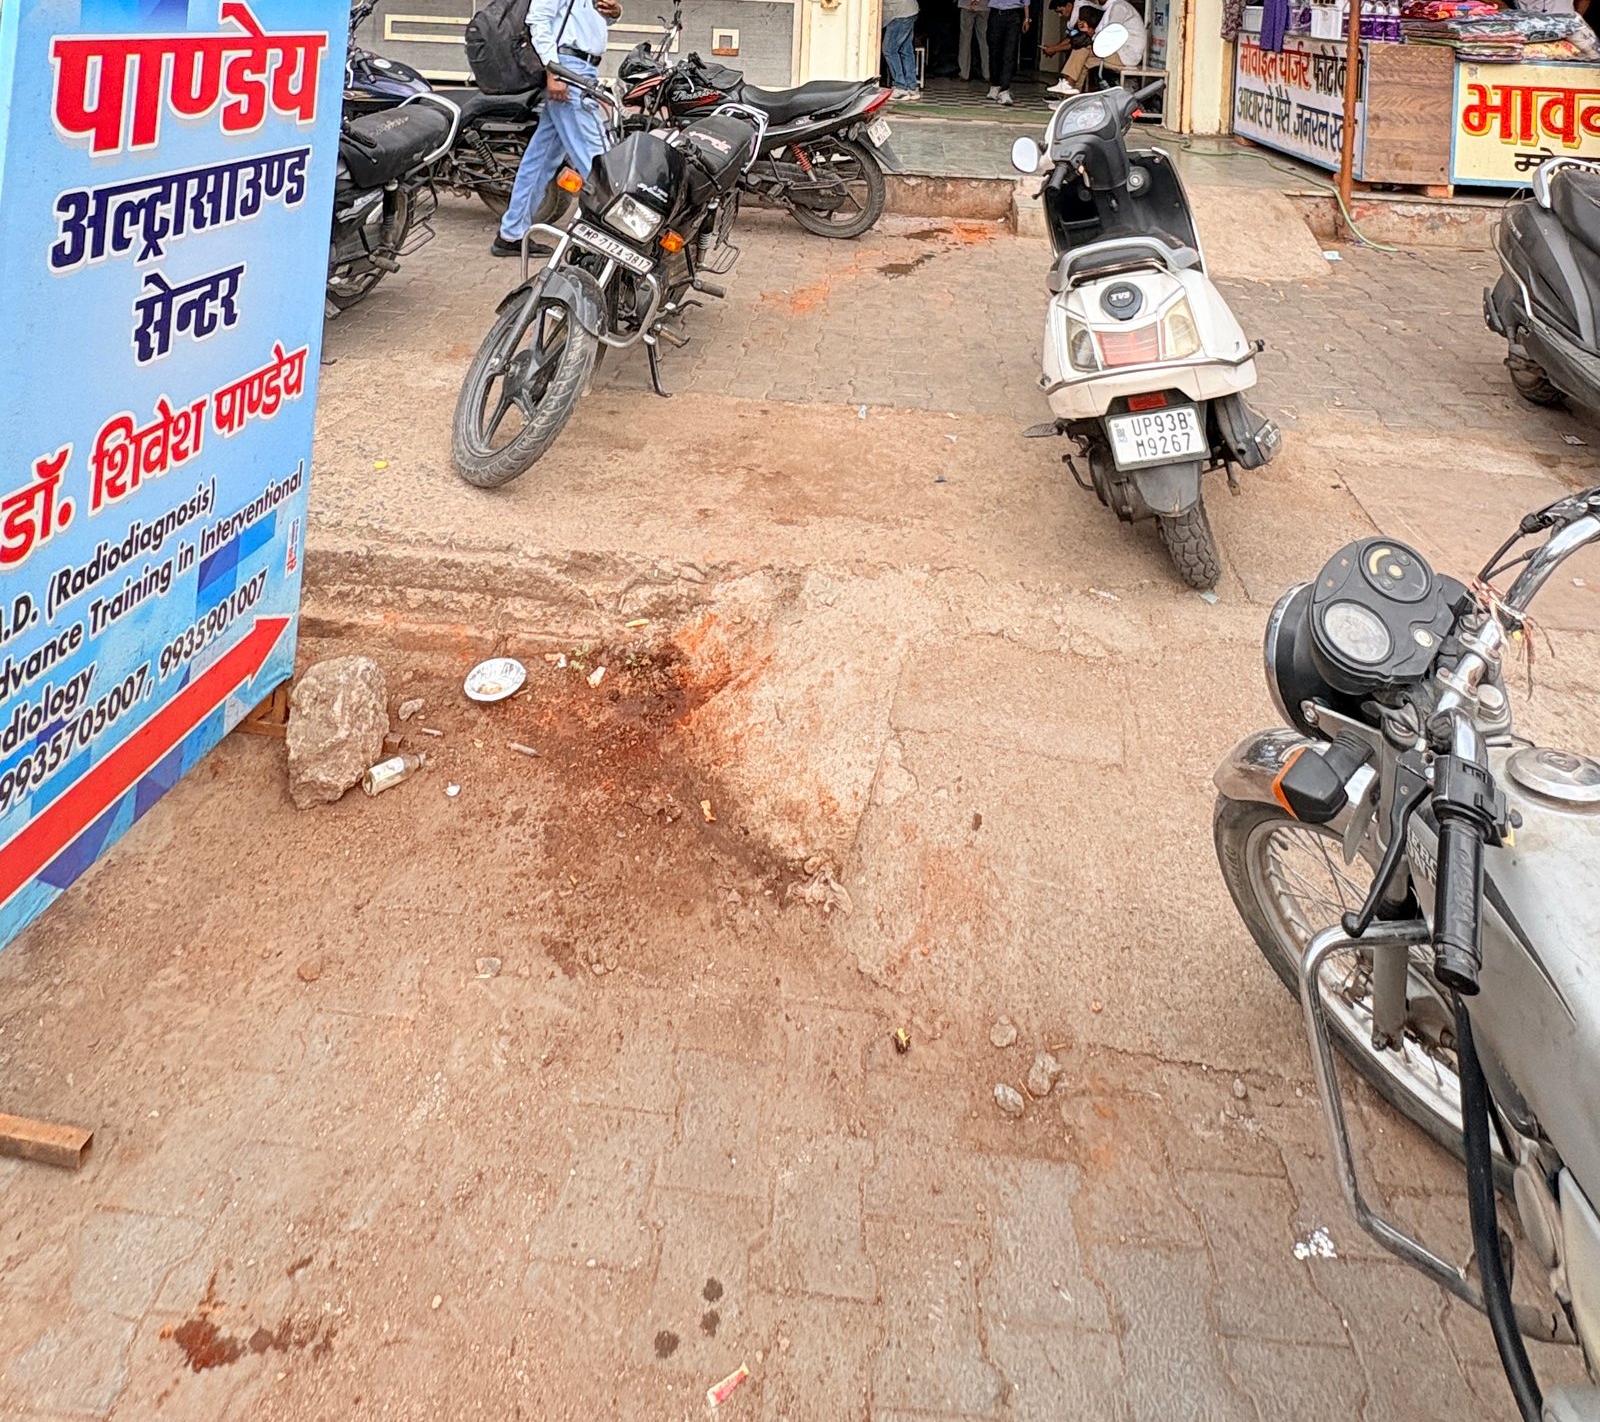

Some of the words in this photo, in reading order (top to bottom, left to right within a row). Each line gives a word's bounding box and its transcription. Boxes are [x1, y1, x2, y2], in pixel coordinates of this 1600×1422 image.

[53, 0, 327, 155] पाण्डेय
[51, 149, 310, 268] अल्ट्रासाउण्ड
[134, 265, 246, 363] सेन्टर
[1111, 292, 1130, 301] TVS
[92, 399, 207, 509] शिवेश
[215, 343, 307, 434] पाण्डेय
[1131, 412, 1189, 437] UP93B
[0, 624, 82, 698] dvance
[90, 560, 172, 634] Training
[178, 543, 194, 572] in
[200, 464, 302, 557] Interventional
[49, 478, 216, 619] (Radiodiagnosis)
[160, 570, 267, 677] 9935901007
